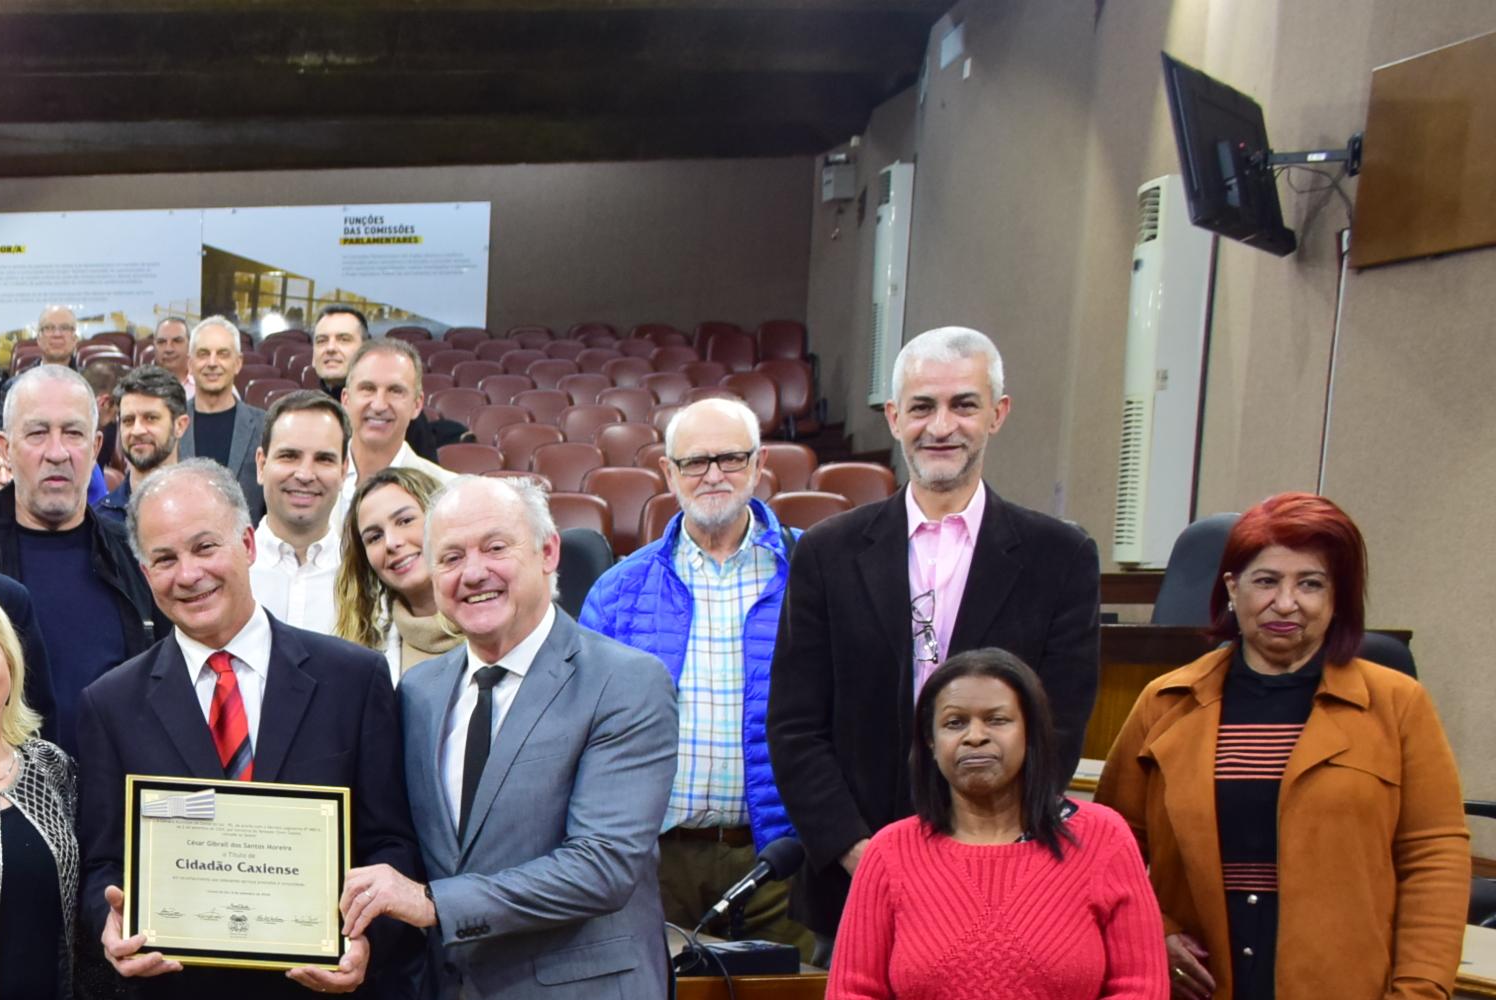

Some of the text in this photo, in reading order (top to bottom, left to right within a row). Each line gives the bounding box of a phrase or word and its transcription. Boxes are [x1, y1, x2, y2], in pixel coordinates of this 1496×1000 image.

[344, 214, 384, 226] FUNÇÕES
[343, 224, 415, 235] DAS COMISSÕES
[343, 236, 419, 245] PARLAMENTARES
[243, 842, 265, 850] Santos
[266, 843, 292, 851] Moreira
[175, 858, 300, 875] Cidadão Caxiense
